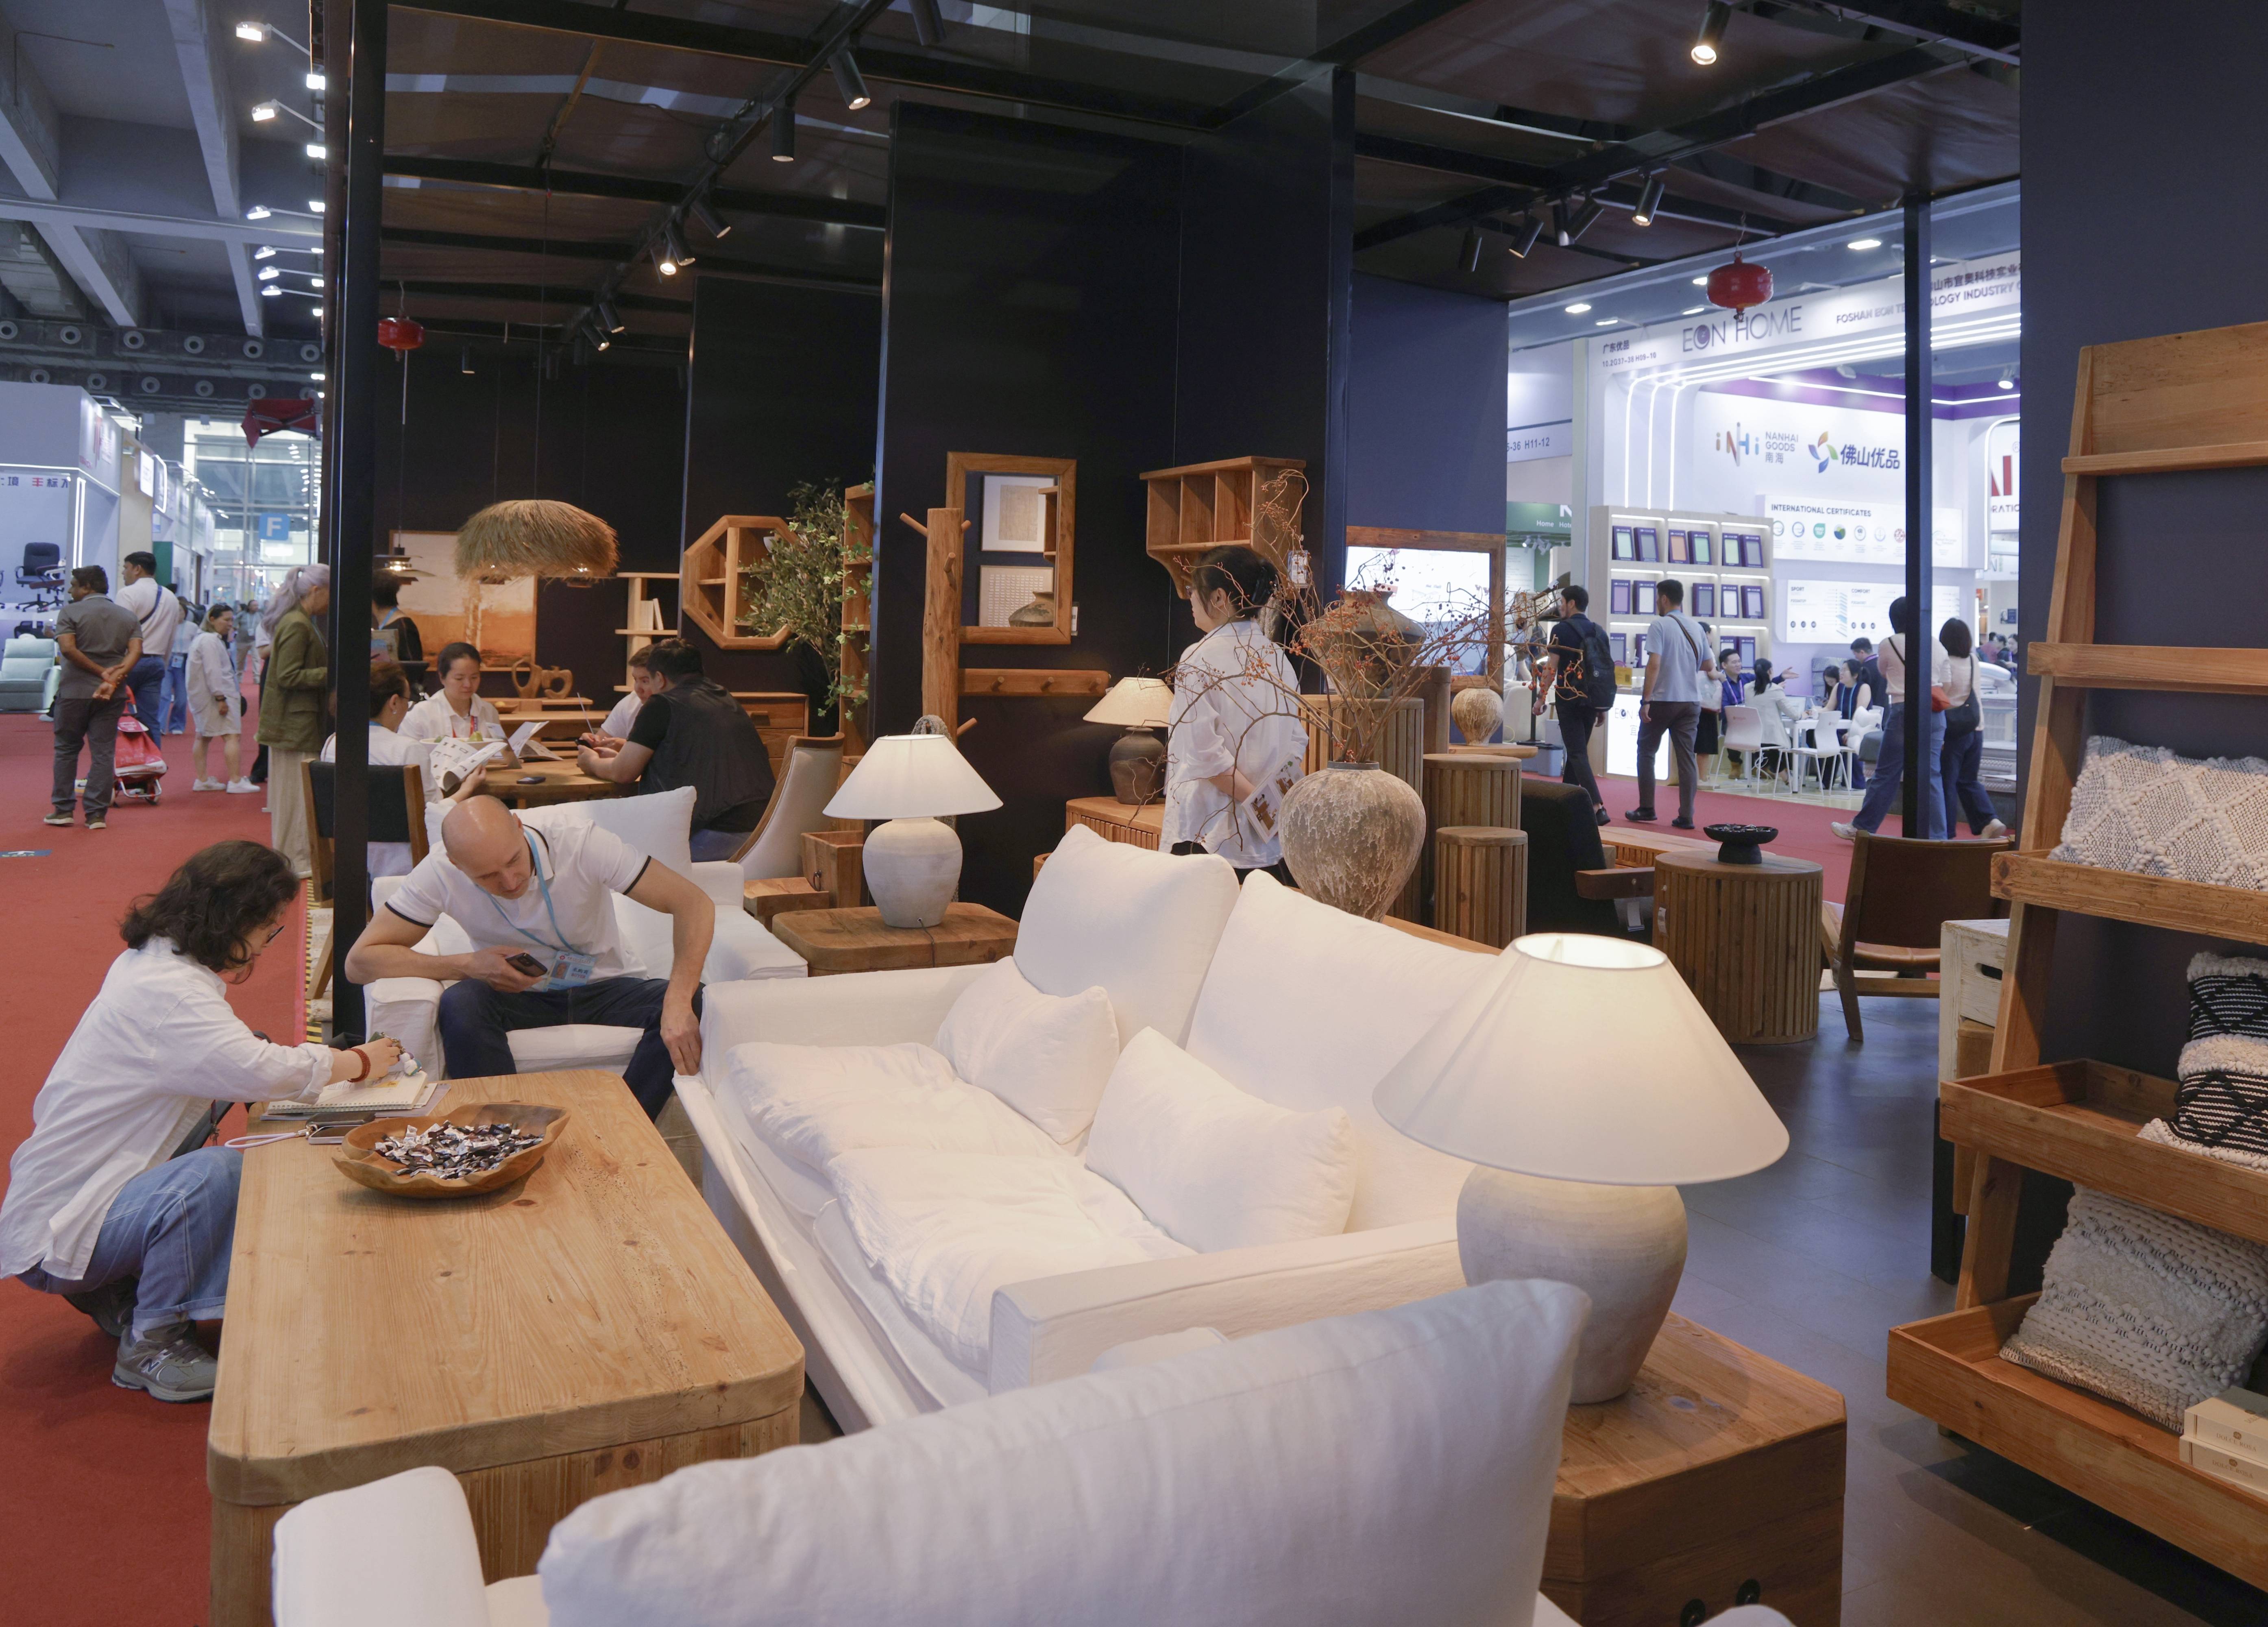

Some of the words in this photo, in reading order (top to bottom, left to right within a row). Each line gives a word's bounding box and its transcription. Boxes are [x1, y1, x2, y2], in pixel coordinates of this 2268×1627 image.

[1964, 281, 2014, 300] INDUSTRY
[1837, 310, 1872, 324] FOSHAN
[1683, 321, 1726, 353] EON
[1736, 306, 1802, 342] HOME
[1603, 340, 1630, 354] 广东优品
[1603, 355, 1634, 367] 10.2G37-38
[1635, 352, 1656, 361] H09-10
[1525, 437, 1550, 449] H11-12
[1765, 432, 1799, 443] NANHAI
[1766, 441, 1795, 451] GOODS
[1841, 444, 1900, 469] 佛山优品
[1771, 504, 1825, 514] INTERNATIONAL
[1826, 508, 1871, 517] CERTIFICATES
[266, 517, 282, 537] F
[1630, 725, 1637, 735] 宜
[2217, 1433, 2237, 1444] DOLCE
[2240, 1442, 2257, 1452] ROSA
[2213, 1459, 2234, 1471] DOLCE
[2236, 1469, 2253, 1479] ROSA
